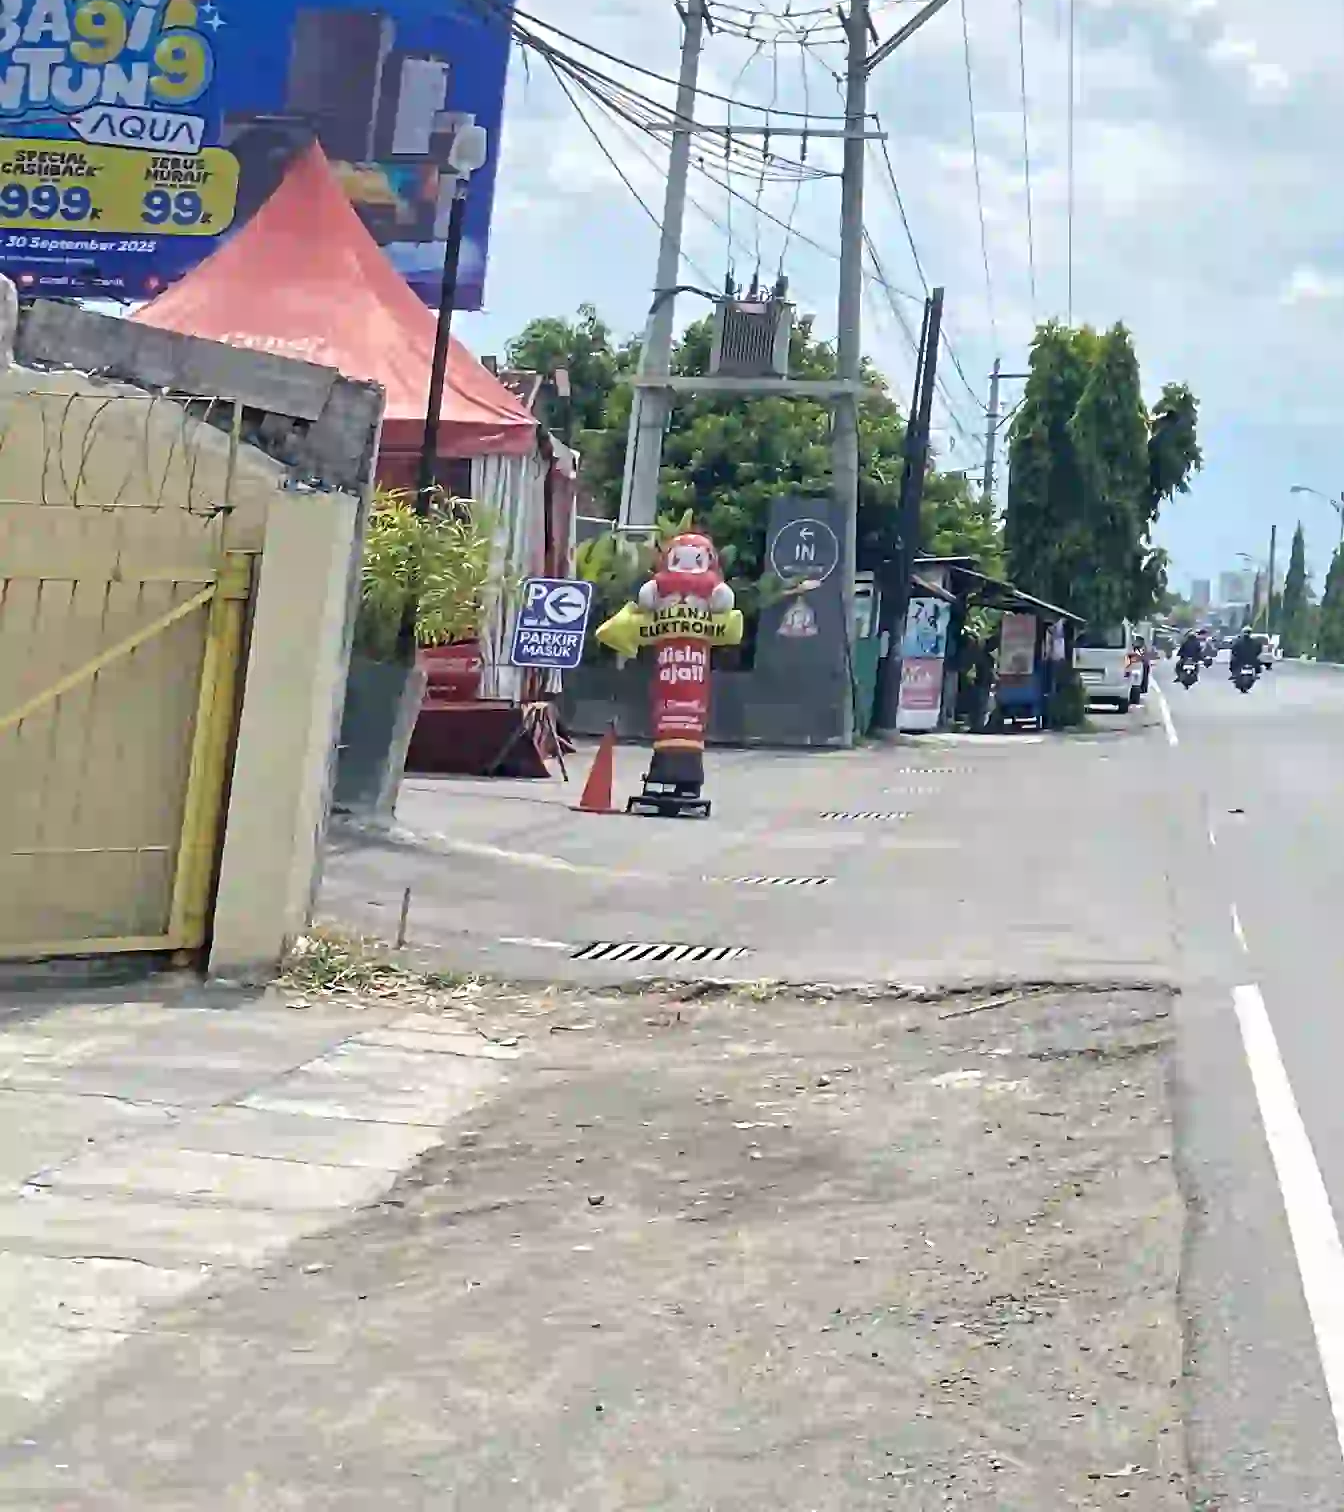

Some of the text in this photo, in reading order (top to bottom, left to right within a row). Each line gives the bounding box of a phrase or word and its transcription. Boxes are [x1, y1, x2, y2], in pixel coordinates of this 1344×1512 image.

[5, 235, 27, 248] 30
[28, 237, 116, 252] September
[795, 544, 816, 561] IN
[527, 583, 548, 608] P
[520, 631, 578, 648] PARKIR
[521, 644, 571, 658] MASUK
